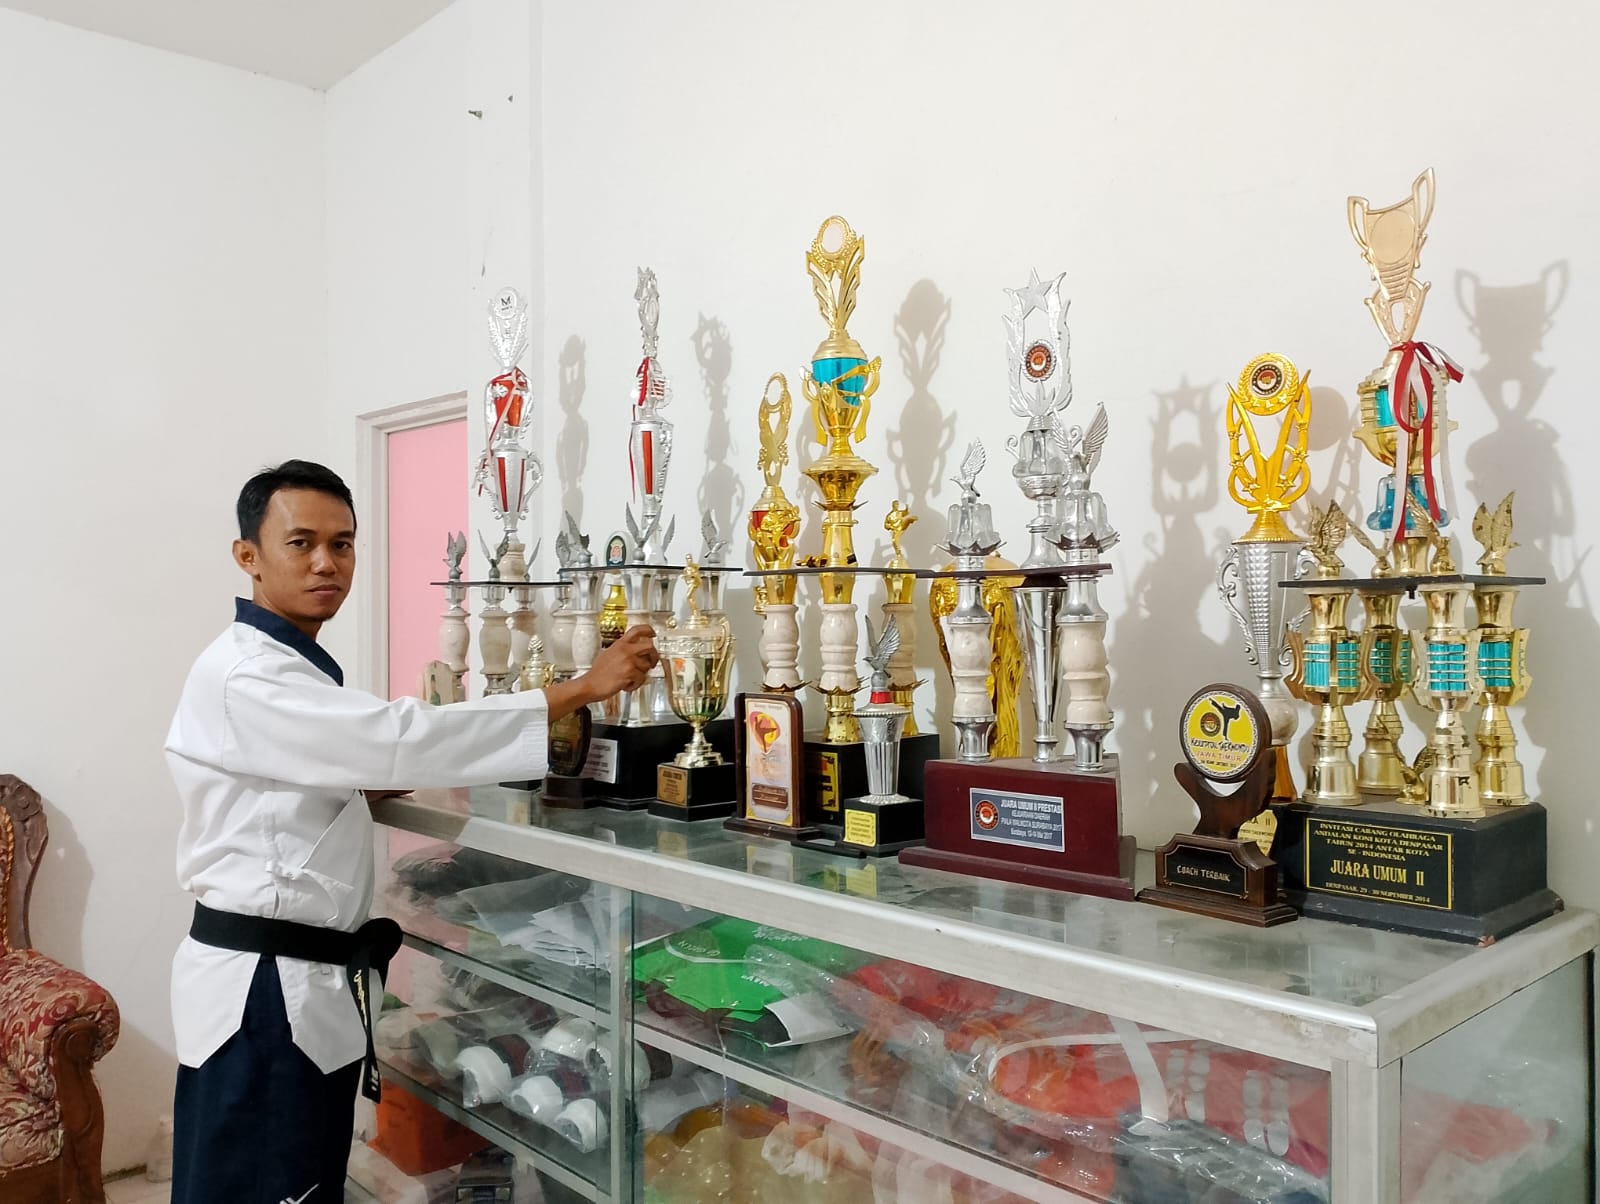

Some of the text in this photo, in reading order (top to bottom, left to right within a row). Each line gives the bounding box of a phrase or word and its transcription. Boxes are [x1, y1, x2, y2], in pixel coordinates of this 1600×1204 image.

[1001, 799, 1018, 809] JUARA
[1038, 803, 1062, 814] PRESTAS
[1313, 830, 1443, 851] ANDALAN KONI KOTA DENPASAR
[1320, 823, 1436, 842] INVITASI CABANG OLAHRAGA
[1326, 838, 1430, 857] TAHUN 2014 ANTAR KOTA
[1347, 848, 1357, 856] SE
[1362, 850, 1406, 862] INDONESIA
[1176, 865, 1231, 882] COACH TERBAIK
[1330, 859, 1425, 887] JUARA UMUM II
[1414, 895, 1431, 904] 2014
